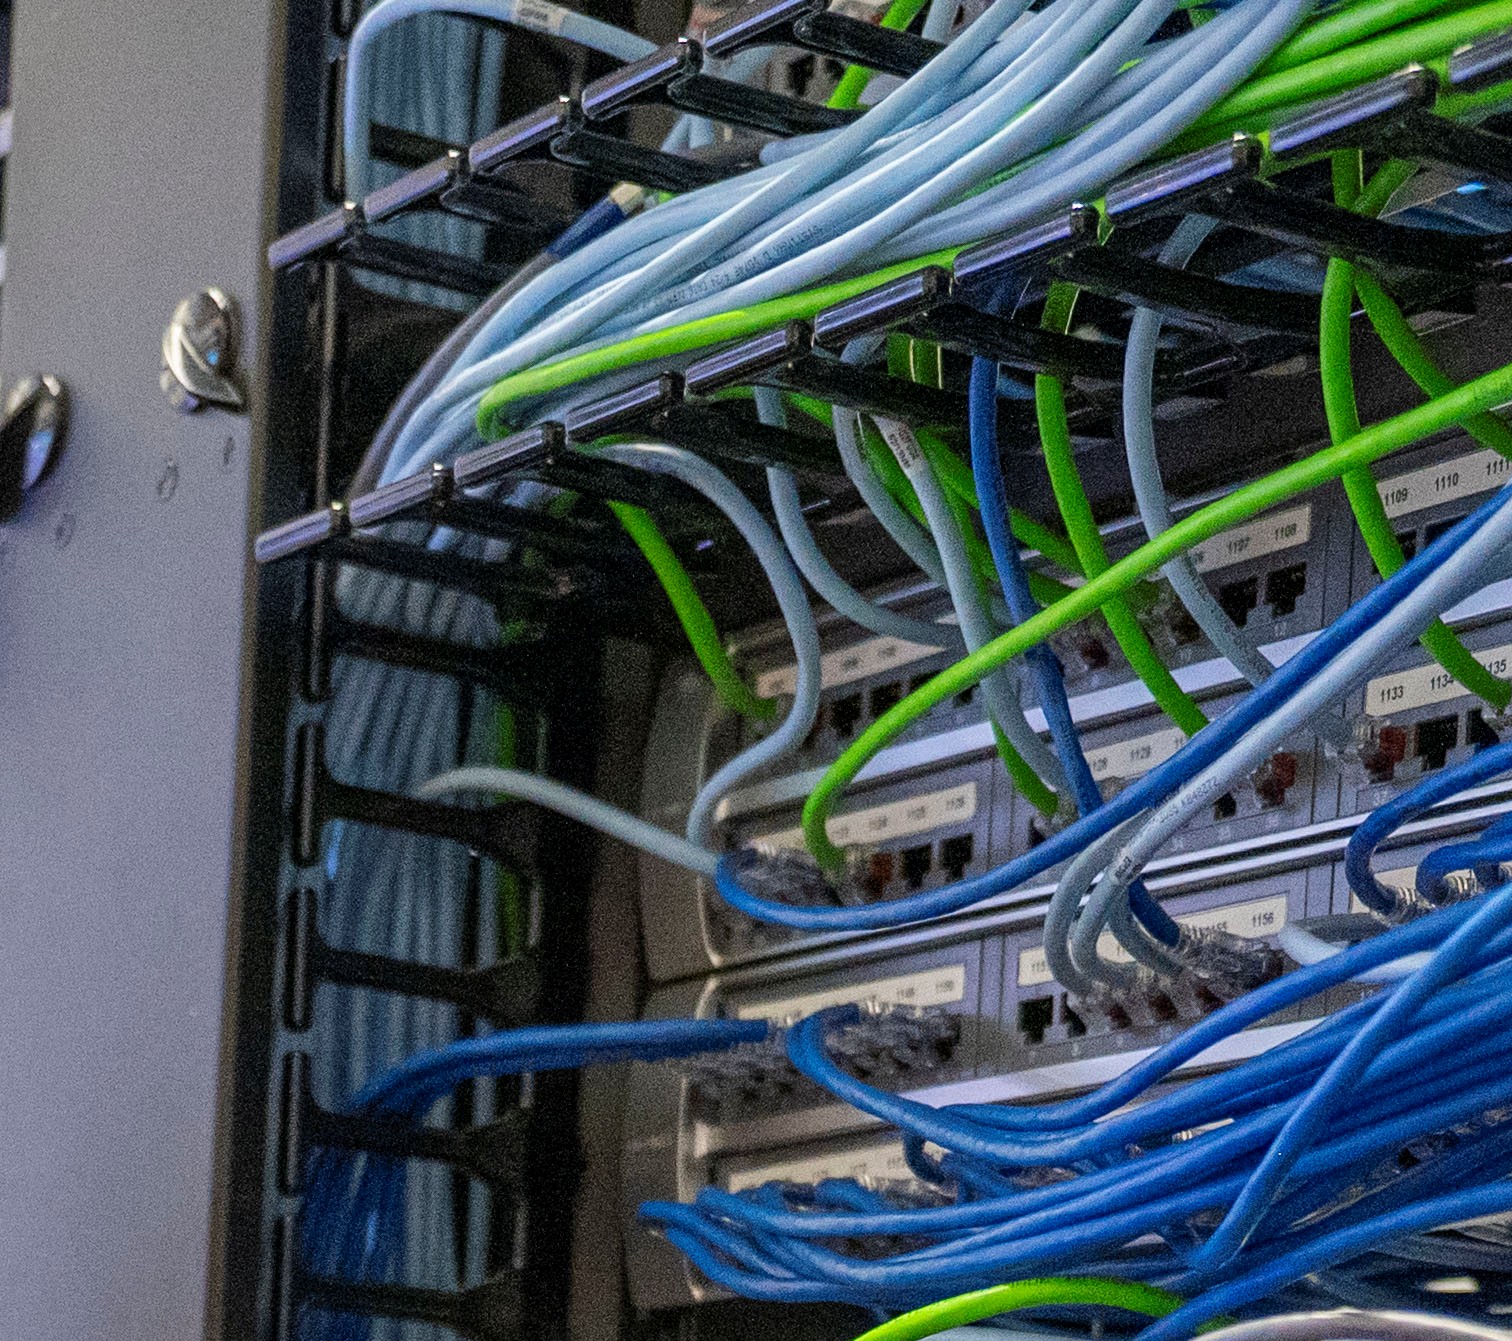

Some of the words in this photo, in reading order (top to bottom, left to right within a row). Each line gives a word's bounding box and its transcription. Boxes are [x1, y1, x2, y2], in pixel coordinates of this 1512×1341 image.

[1383, 487, 1409, 507] 1109
[1434, 472, 1460, 491] 1110
[1380, 686, 1404, 703] 1133
